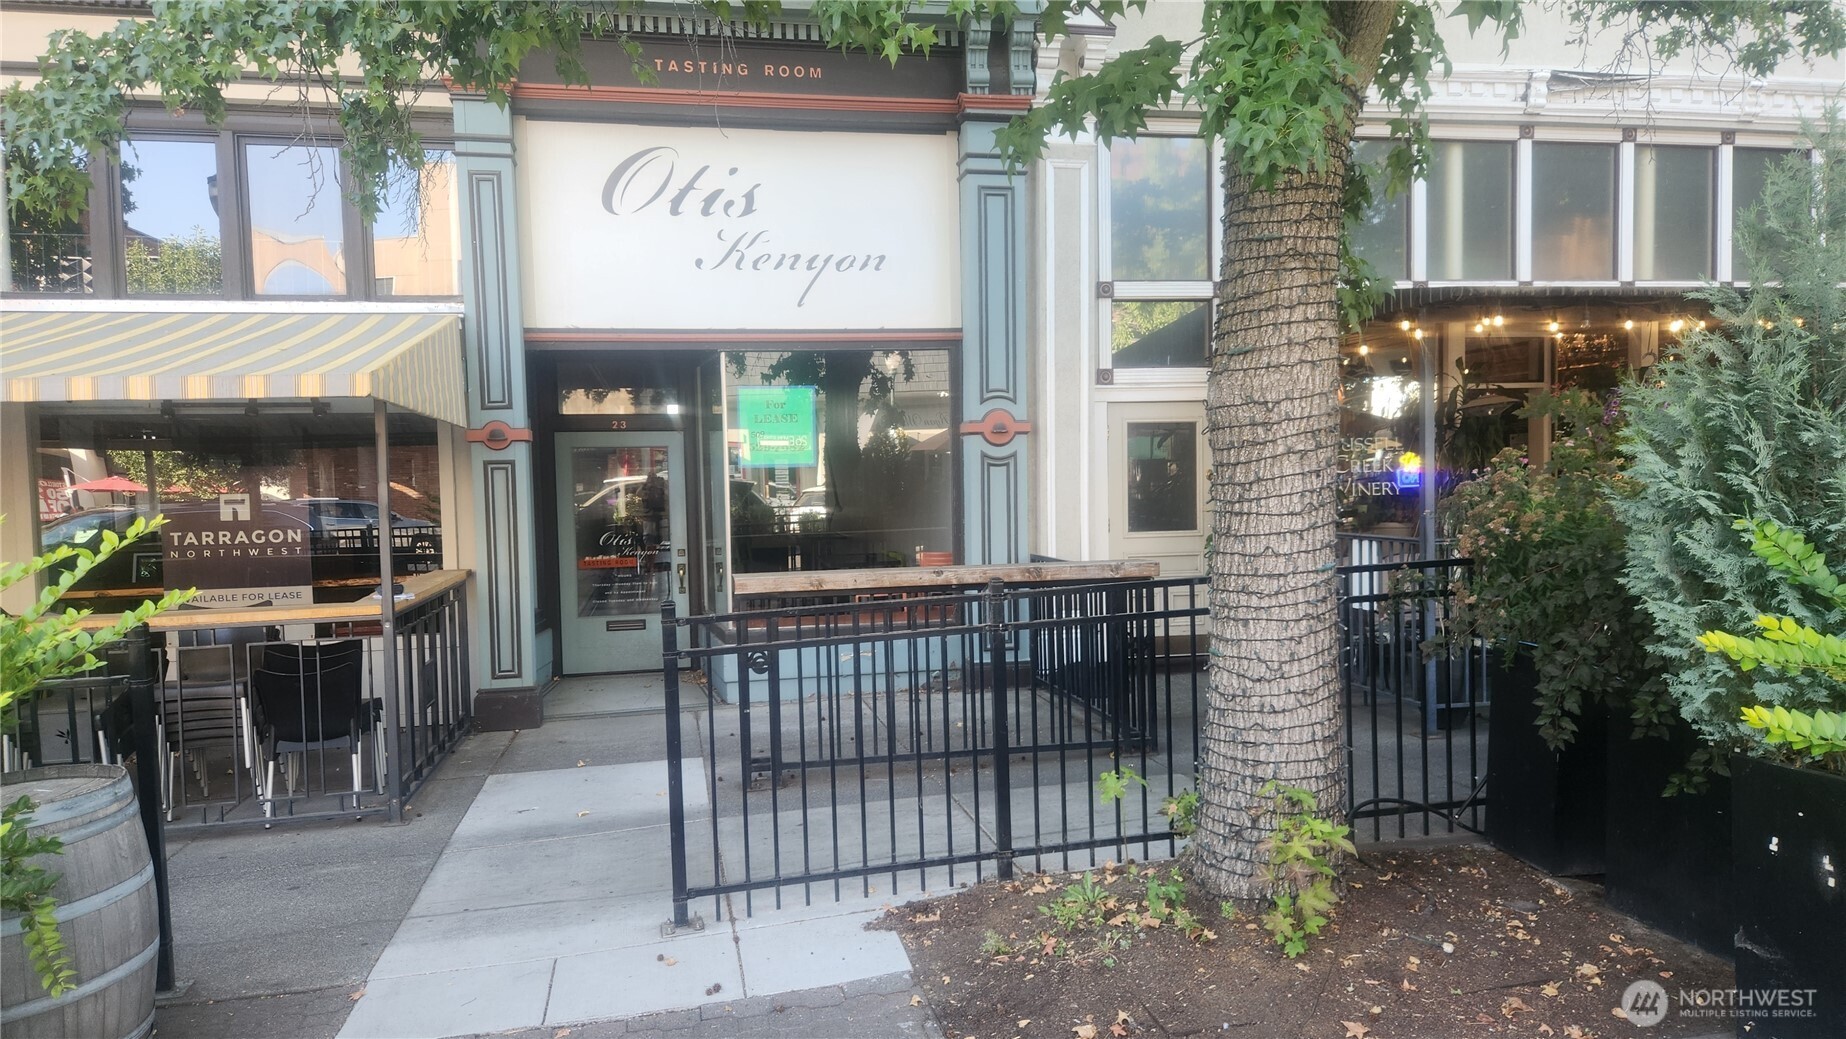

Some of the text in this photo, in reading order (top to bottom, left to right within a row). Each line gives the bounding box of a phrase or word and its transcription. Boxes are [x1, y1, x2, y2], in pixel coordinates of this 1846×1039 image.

[654, 58, 823, 79] TASTING ROOM
[601, 146, 762, 218] Otis
[695, 229, 887, 308] Kenyon
[765, 400, 786, 409] For
[612, 420, 627, 429] 23
[754, 413, 798, 424] LEASE
[1340, 436, 1405, 452] USSELL
[169, 528, 302, 546] TARRAGON
[599, 531, 634, 546] Otis
[170, 547, 302, 558] NORTHWEST
[617, 546, 659, 562] Kenyon
[242, 592, 265, 602] FOR
[268, 591, 303, 600] LEASE
